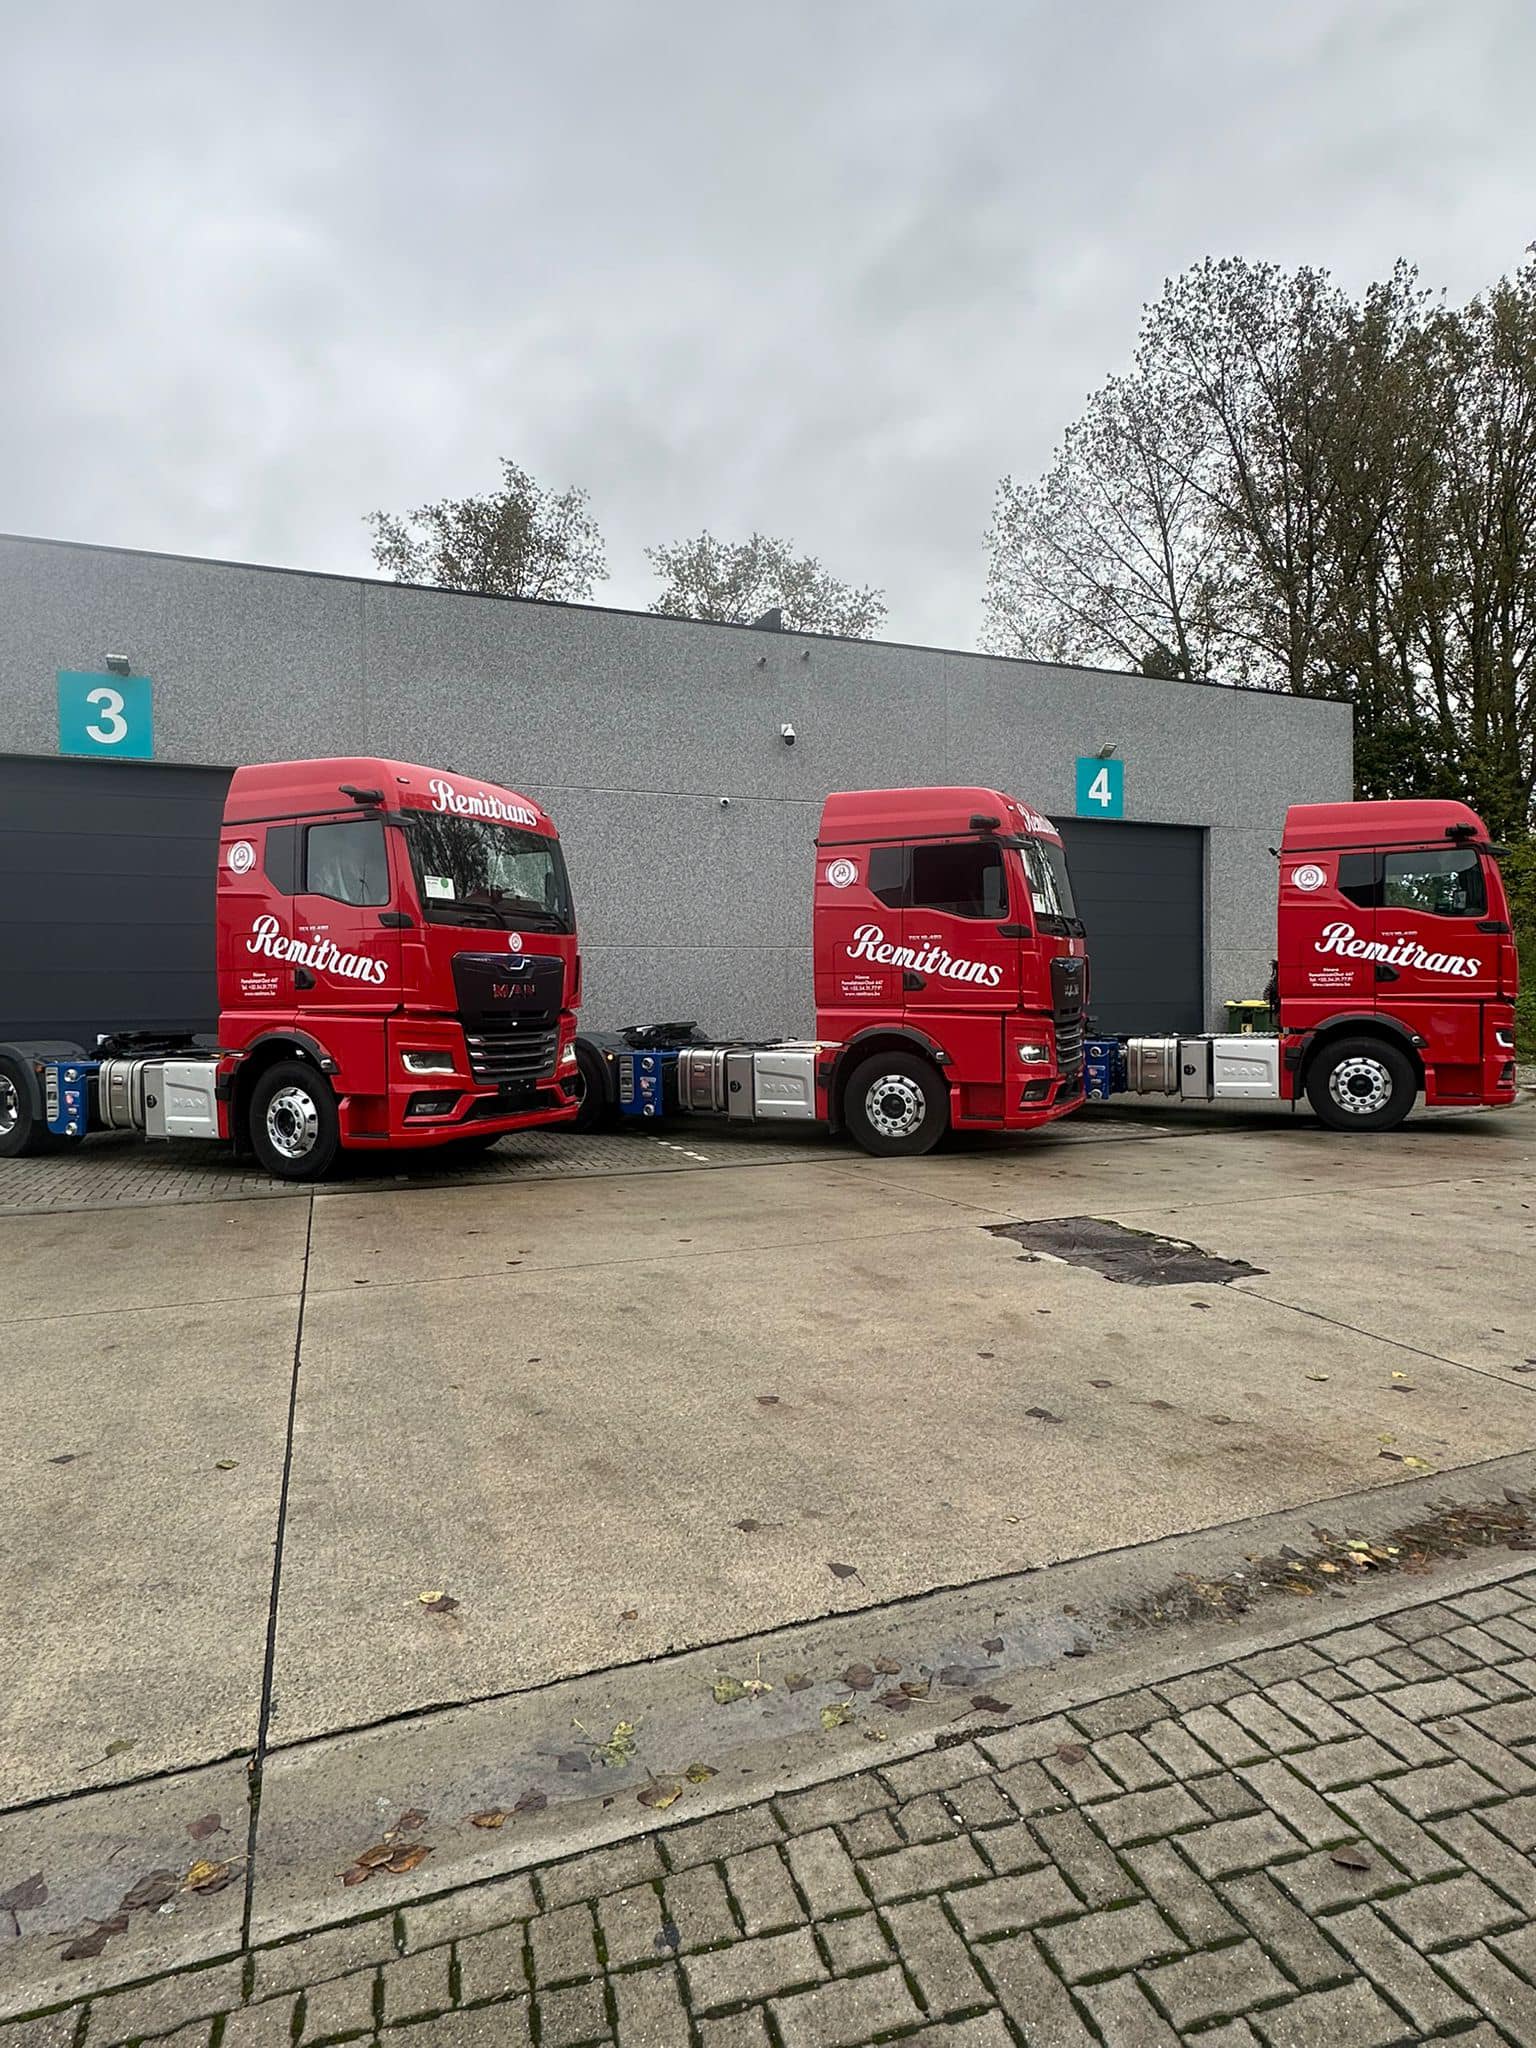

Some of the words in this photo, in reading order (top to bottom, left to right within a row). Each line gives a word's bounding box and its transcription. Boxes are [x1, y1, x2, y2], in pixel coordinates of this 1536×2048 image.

[86, 687, 127, 744] 3
[429, 779, 537, 826] Remitrans
[1088, 767, 1112, 807] 4
[246, 914, 389, 984] Remitrans
[846, 924, 1003, 986] Remitrans
[1314, 922, 1482, 978] Remitrans
